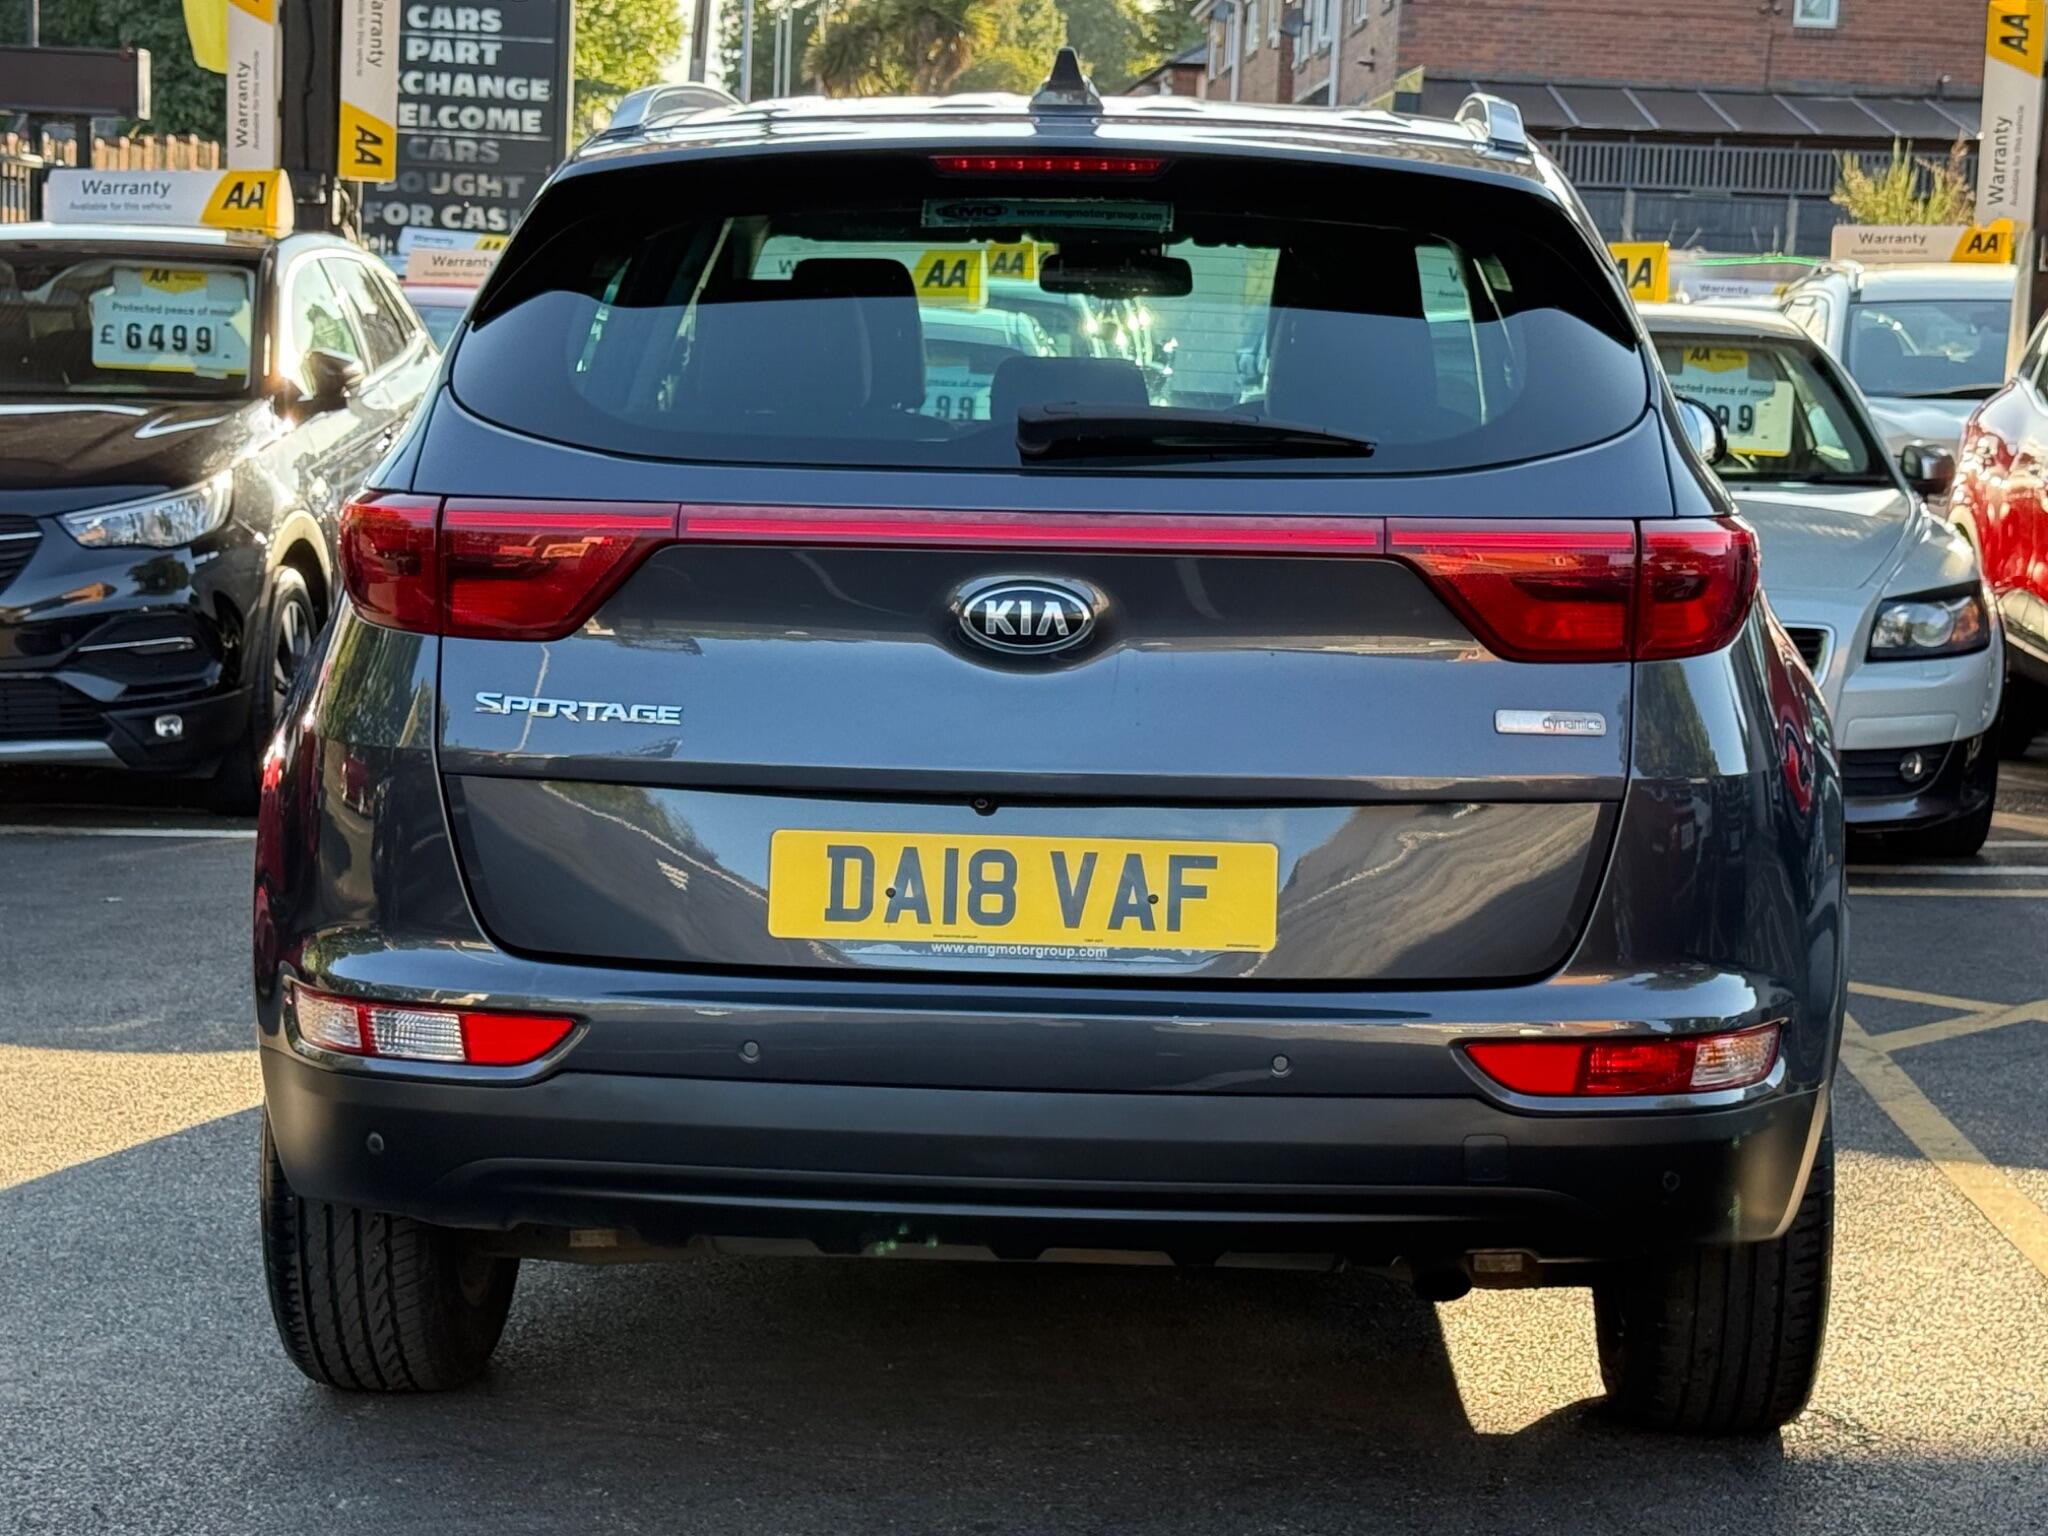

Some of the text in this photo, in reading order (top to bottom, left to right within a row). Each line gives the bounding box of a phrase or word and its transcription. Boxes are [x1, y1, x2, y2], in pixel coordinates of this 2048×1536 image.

[366, 0, 385, 67] arranty
[407, 5, 502, 32] CARS
[1999, 14, 2030, 56] AA
[406, 38, 502, 65] PART
[398, 70, 550, 101] CHANGE
[236, 61, 251, 148] Warranty
[399, 102, 542, 133] ELCOME
[355, 124, 383, 166] AA
[407, 136, 500, 163] CARS
[1987, 116, 2013, 206] Warranty
[81, 180, 266, 210] Warranty AA
[364, 201, 434, 227] FOR
[1859, 232, 1999, 254] Warranty AA
[922, 259, 968, 289] AA
[992, 252, 1025, 274] AA
[112, 302, 162, 314] Protected
[164, 307, 194, 316] peace
[197, 307, 208, 316] of
[984, 599, 1069, 635] KIA
[474, 691, 683, 725] SPORTAGE
[1543, 716, 1601, 731] dynamics
[824, 844, 1218, 932] DA18 VAF
[931, 943, 1108, 959] www.emgmotorgroup.com
